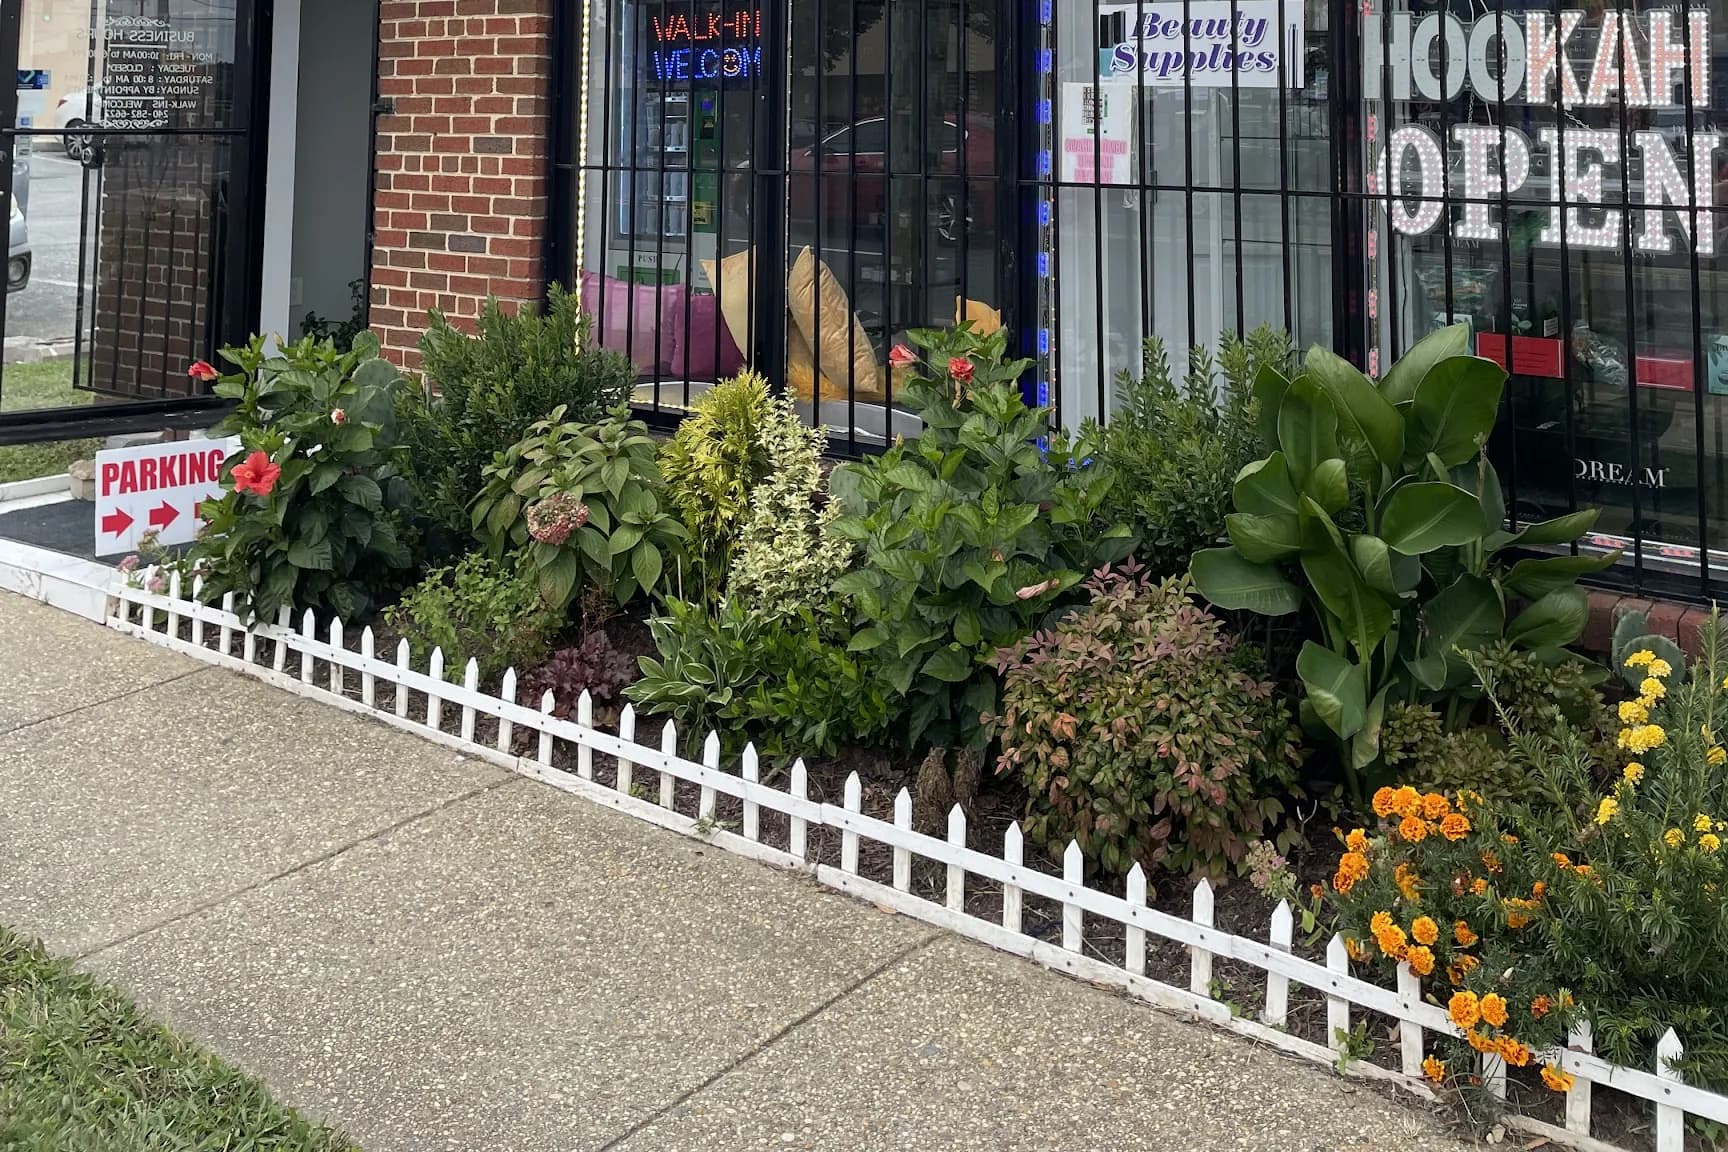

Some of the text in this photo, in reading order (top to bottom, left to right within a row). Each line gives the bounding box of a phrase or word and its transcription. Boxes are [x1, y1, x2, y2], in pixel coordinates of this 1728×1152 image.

[1131, 10, 1267, 45] Beauty
[1114, 44, 1277, 77] Supplies
[1363, 11, 1709, 106] HOOKAH
[1377, 126, 1720, 254] OPEN
[637, 254, 658, 264] PUS
[102, 449, 224, 497] PARKING
